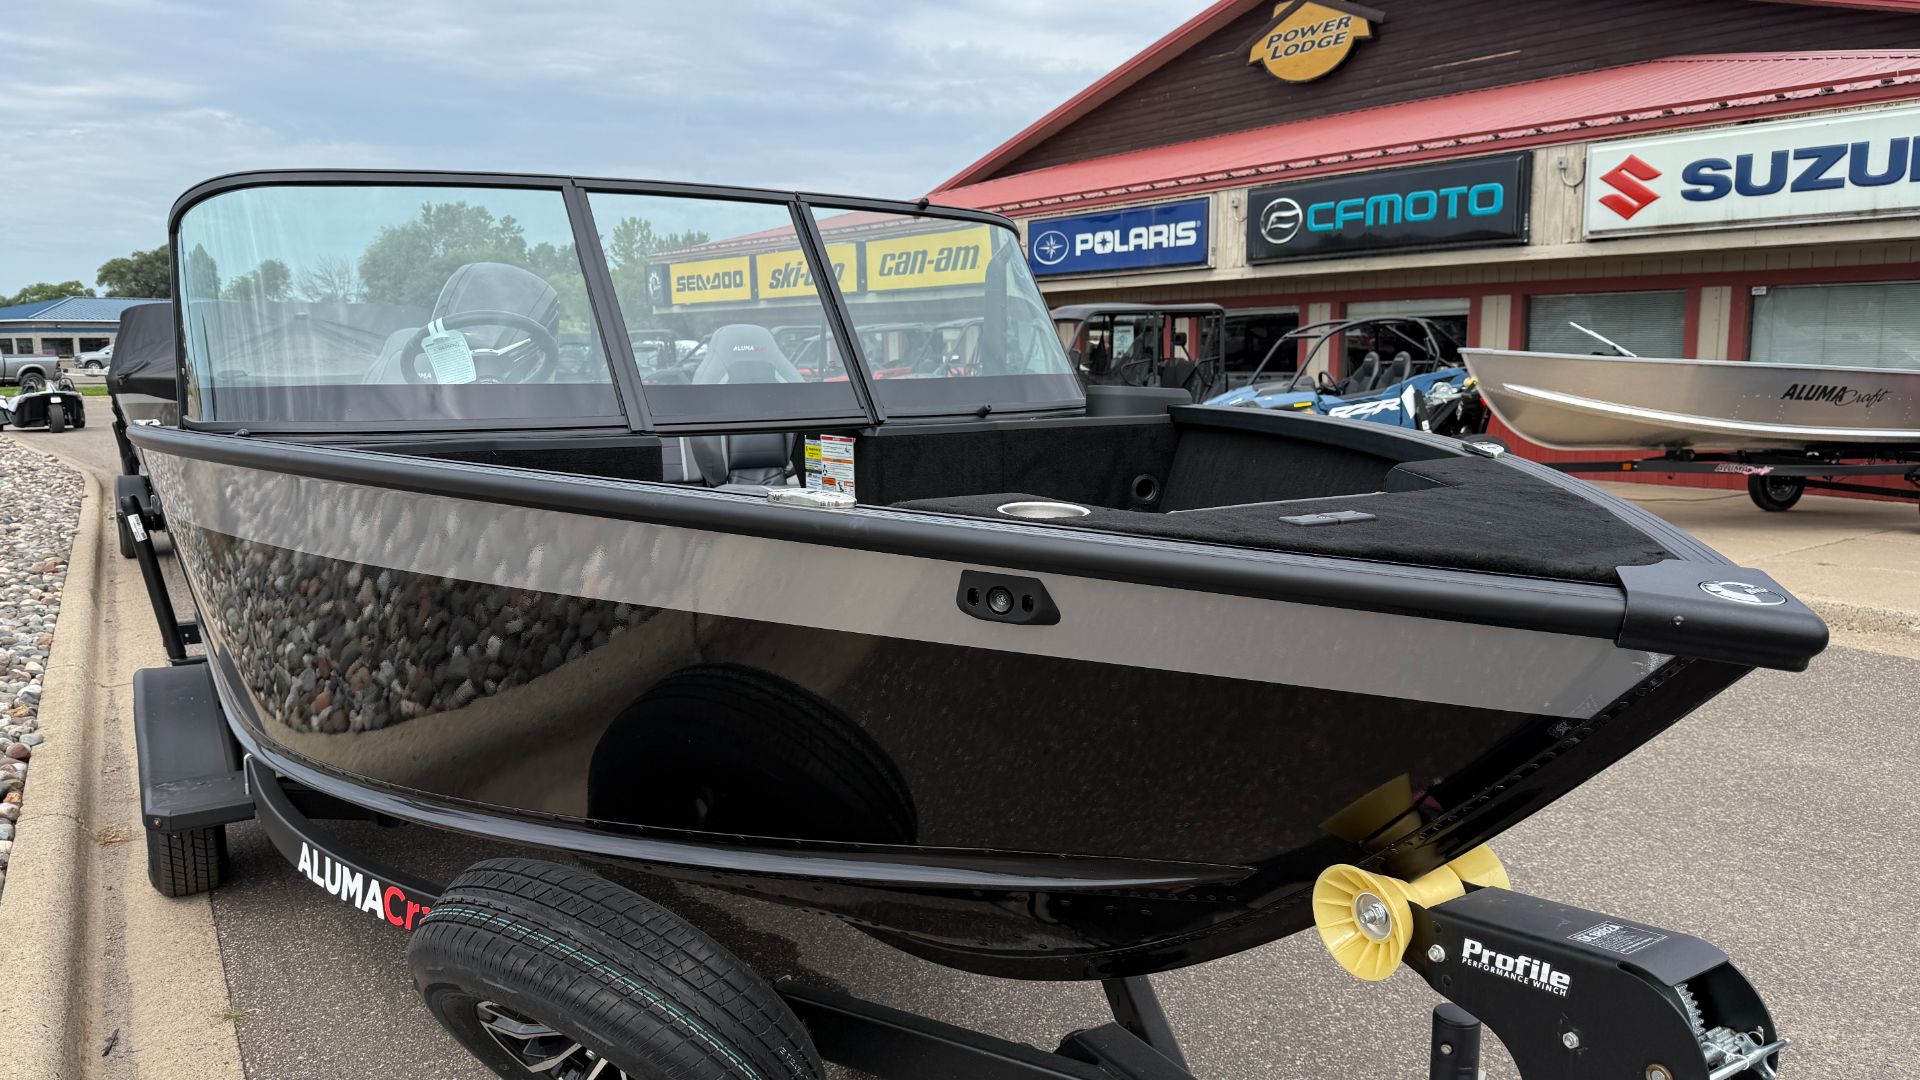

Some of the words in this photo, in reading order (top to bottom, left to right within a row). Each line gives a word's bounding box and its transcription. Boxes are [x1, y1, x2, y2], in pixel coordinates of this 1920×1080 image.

[1266, 16, 1352, 49] POWER
[1271, 32, 1347, 60] LODGE
[1681, 136, 1920, 202] SUZU
[1307, 183, 1504, 232] CFMOTO
[1075, 221, 1198, 256] POLARIS
[879, 244, 980, 277] can-am
[1328, 398, 1400, 418] RZR
[298, 842, 431, 931] ALUMACr
[1462, 938, 1571, 990] Profile
[1462, 958, 1529, 984] PERFORMANCE
[1533, 980, 1566, 996] WINCH
